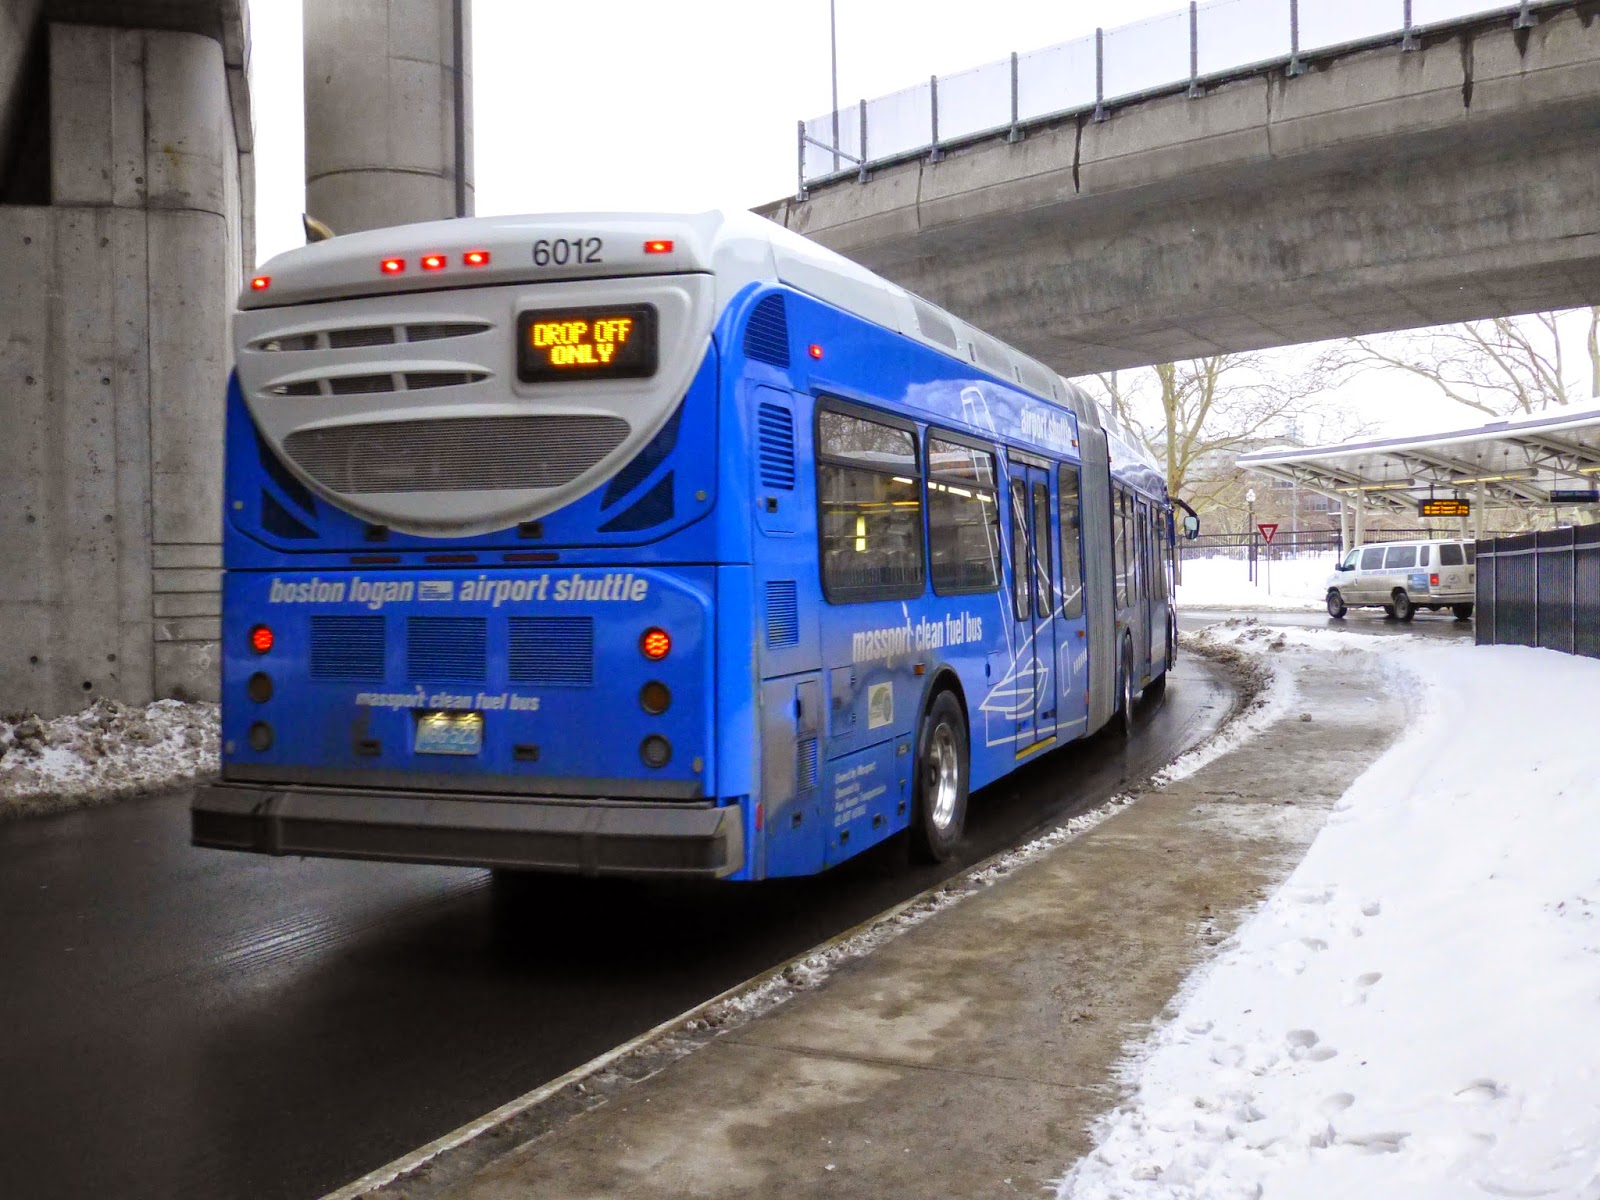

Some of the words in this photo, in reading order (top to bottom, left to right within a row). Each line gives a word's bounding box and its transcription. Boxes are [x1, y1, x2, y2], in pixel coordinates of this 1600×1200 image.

[533, 237, 604, 267] 6012
[533, 322, 588, 346] DROP
[594, 318, 632, 343] OFF
[550, 343, 614, 365] ONLY
[1020, 403, 1048, 444] airport
[269, 577, 346, 603] boston
[349, 576, 416, 610] logan
[458, 574, 550, 608] airport
[552, 573, 648, 602] shuttle
[852, 617, 914, 669] massport
[915, 615, 944, 652] clean
[945, 612, 964, 646] fuel
[965, 610, 983, 643] bus
[429, 692, 473, 709] clean
[474, 692, 509, 710] fuel
[509, 693, 541, 711] bus
